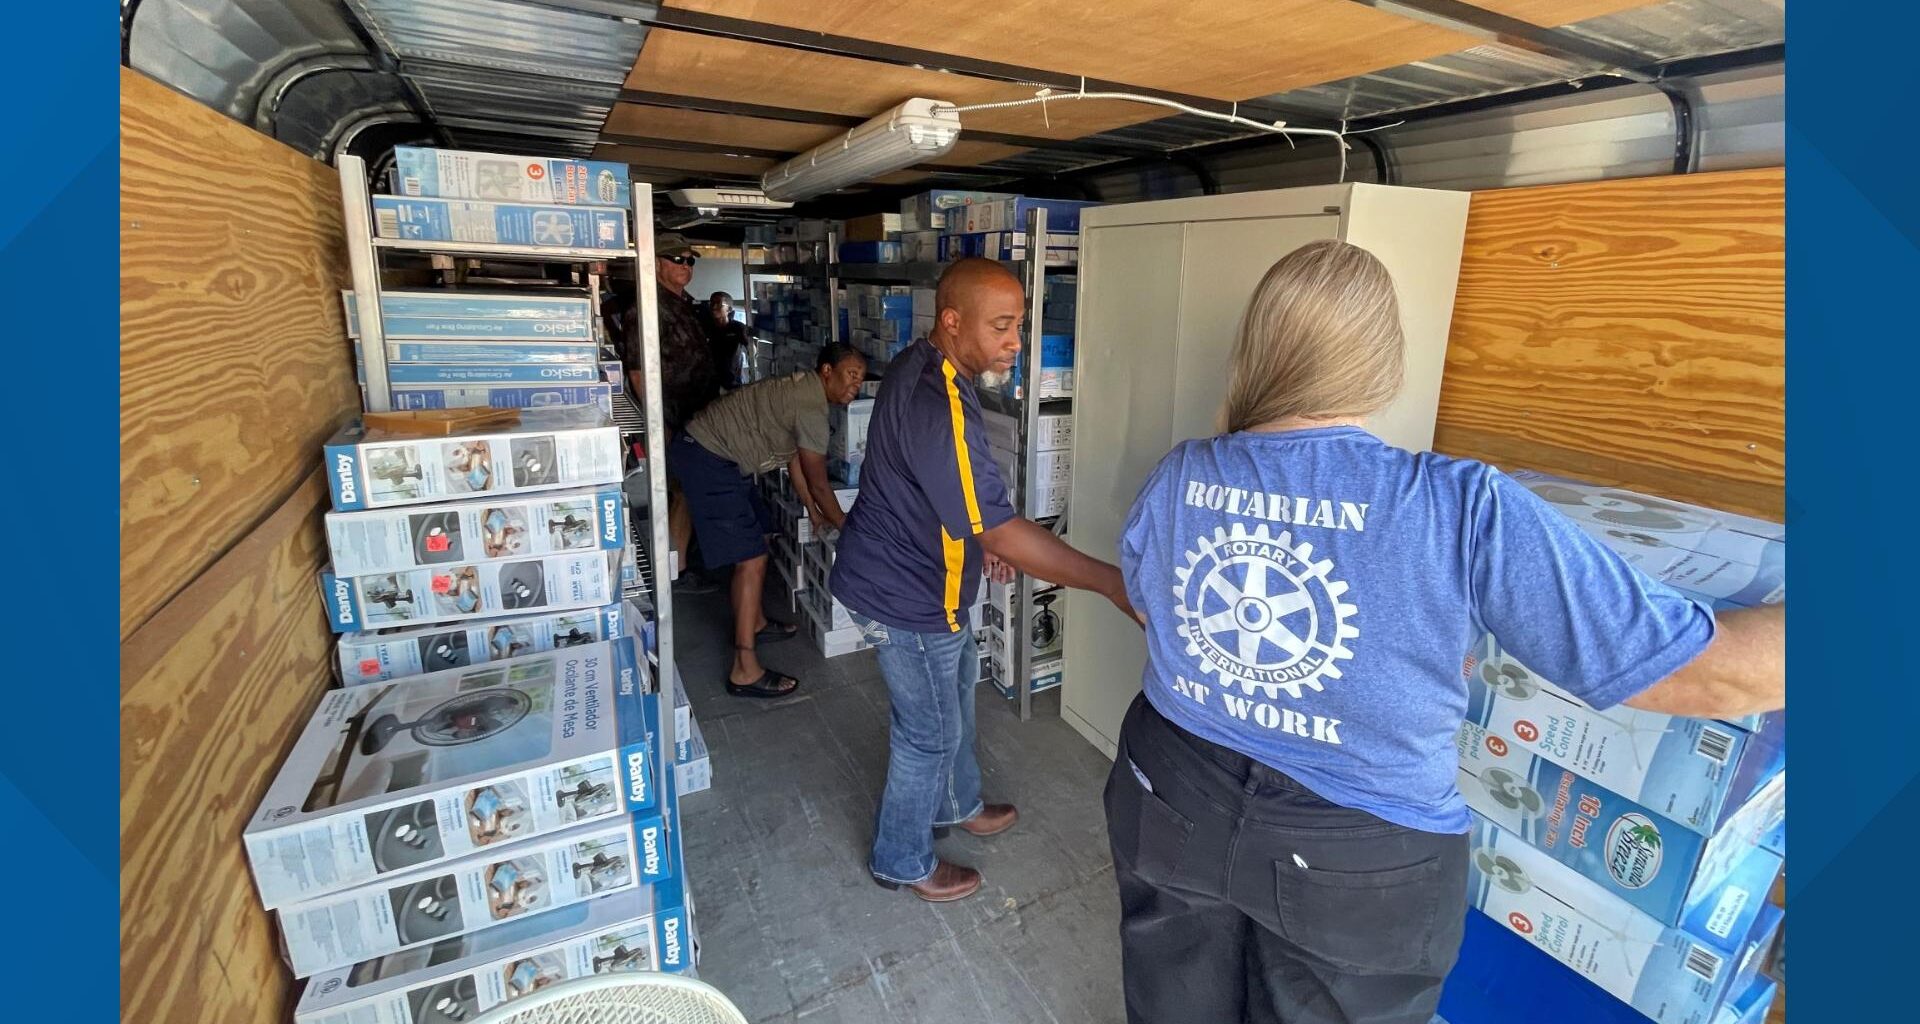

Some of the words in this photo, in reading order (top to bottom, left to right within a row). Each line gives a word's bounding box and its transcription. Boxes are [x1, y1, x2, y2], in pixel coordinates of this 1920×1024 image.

[534, 321, 586, 335] Lasko
[541, 368, 593, 379] Lasko
[337, 453, 357, 504] Danby
[603, 499, 618, 543] Danby
[1184, 480, 1371, 532] ROTARIAN
[1224, 541, 1301, 570] ROTARY
[335, 579, 354, 624] Danby
[584, 658, 599, 669] 30
[1190, 625, 1323, 683] INTERNATIONAL
[563, 659, 579, 699] Oscilante
[584, 669, 597, 681] cm
[620, 668, 634, 695] Danby
[564, 699, 579, 712] de
[584, 682, 601, 731] Ventilador
[1172, 675, 1210, 706] AT
[1223, 693, 1343, 745] WORK
[562, 712, 579, 739] Mesa
[1470, 727, 1486, 760] Speed
[1539, 715, 1559, 752] Speed
[1554, 715, 1577, 758] Control
[628, 751, 645, 802] Danby
[1547, 771, 1575, 828] Oscillating
[1578, 793, 1602, 818] 16
[642, 826, 660, 875] Danby
[1544, 827, 1560, 849] Fan
[1568, 814, 1593, 848] Inch
[1611, 830, 1639, 880] Breeze
[1628, 845, 1655, 888] Sarasota
[664, 917, 680, 965] Danby
[1534, 912, 1553, 946] Speed
[1548, 915, 1569, 953] Control
